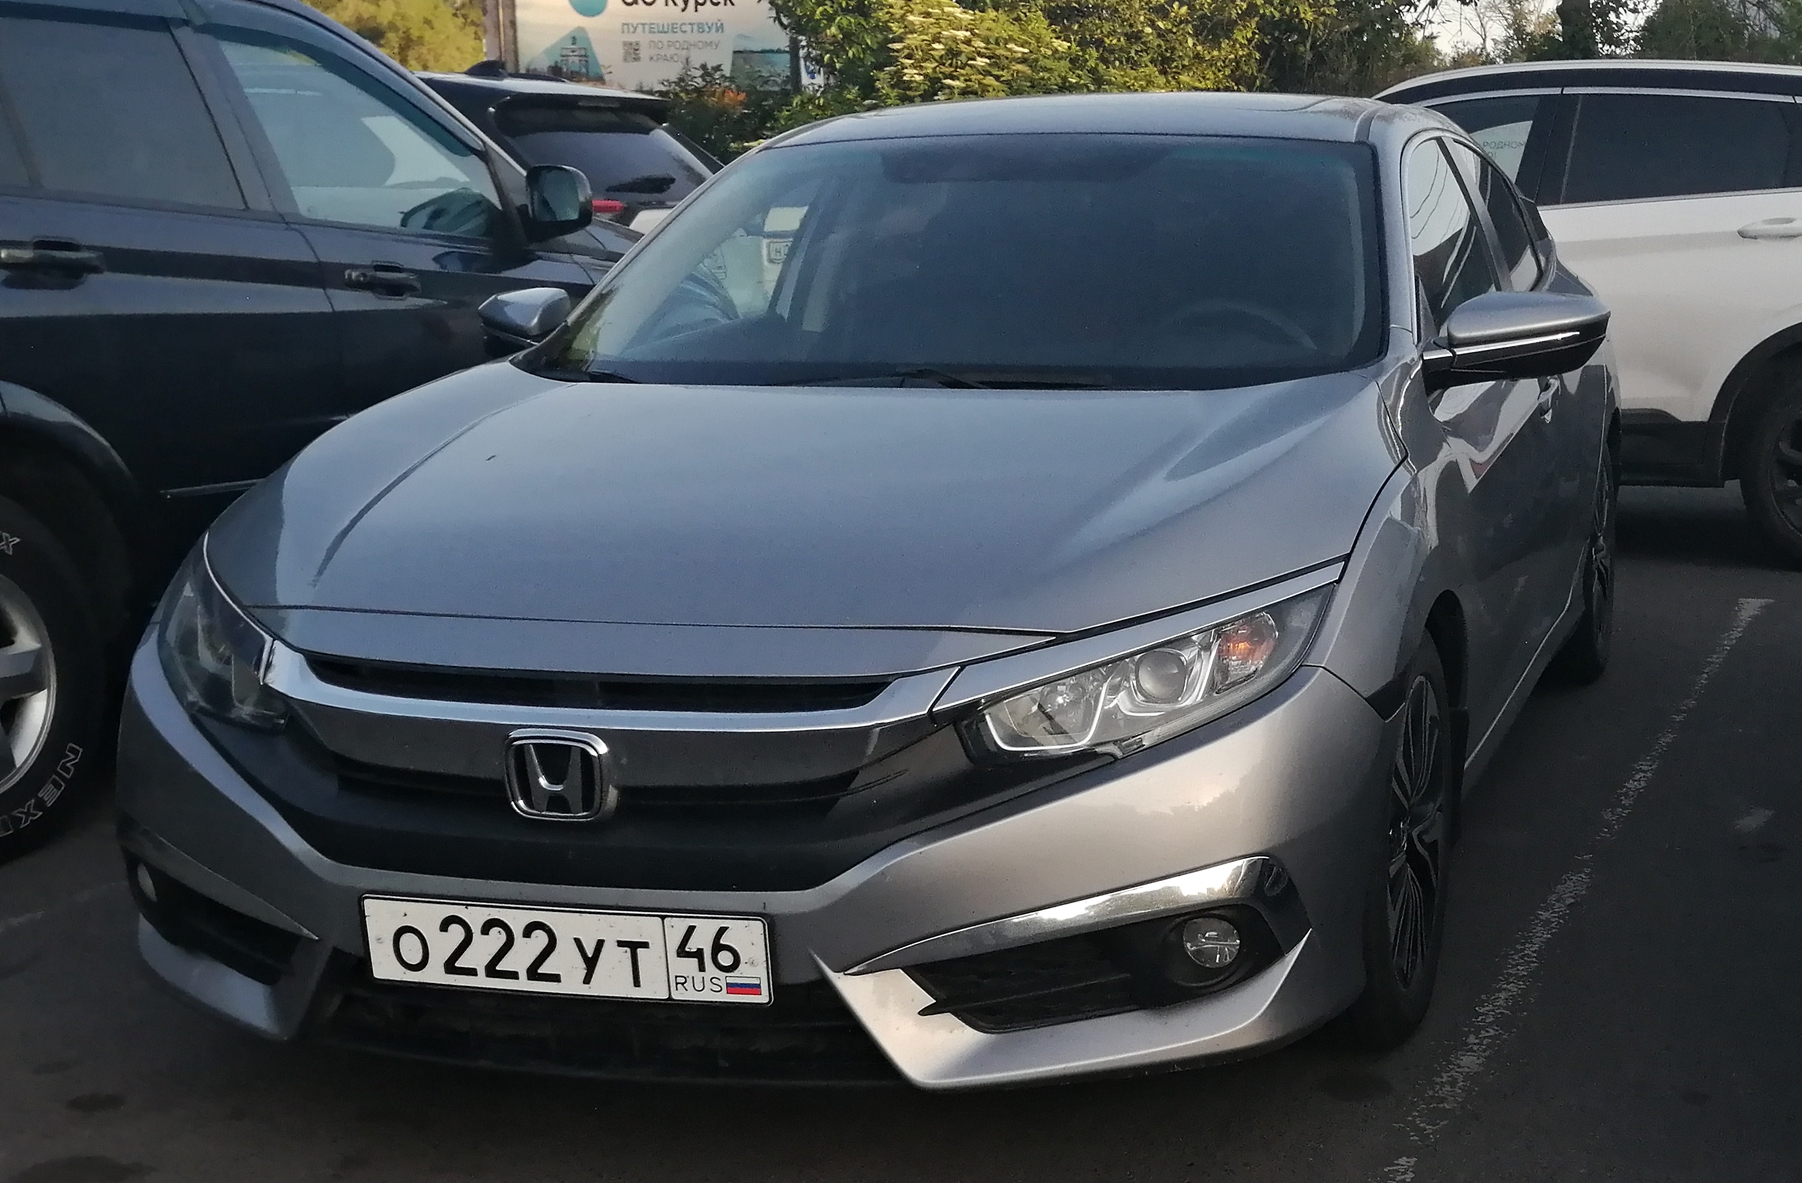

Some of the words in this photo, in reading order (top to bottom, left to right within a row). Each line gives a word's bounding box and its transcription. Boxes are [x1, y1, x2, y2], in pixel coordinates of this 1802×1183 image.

[620, 19, 725, 35] ПУТЕШЕСТВУЙ
[648, 40, 665, 51] ПО
[667, 40, 720, 51] РОДНОМУ
[676, 925, 742, 973] 46
[674, 975, 723, 993] RUS
